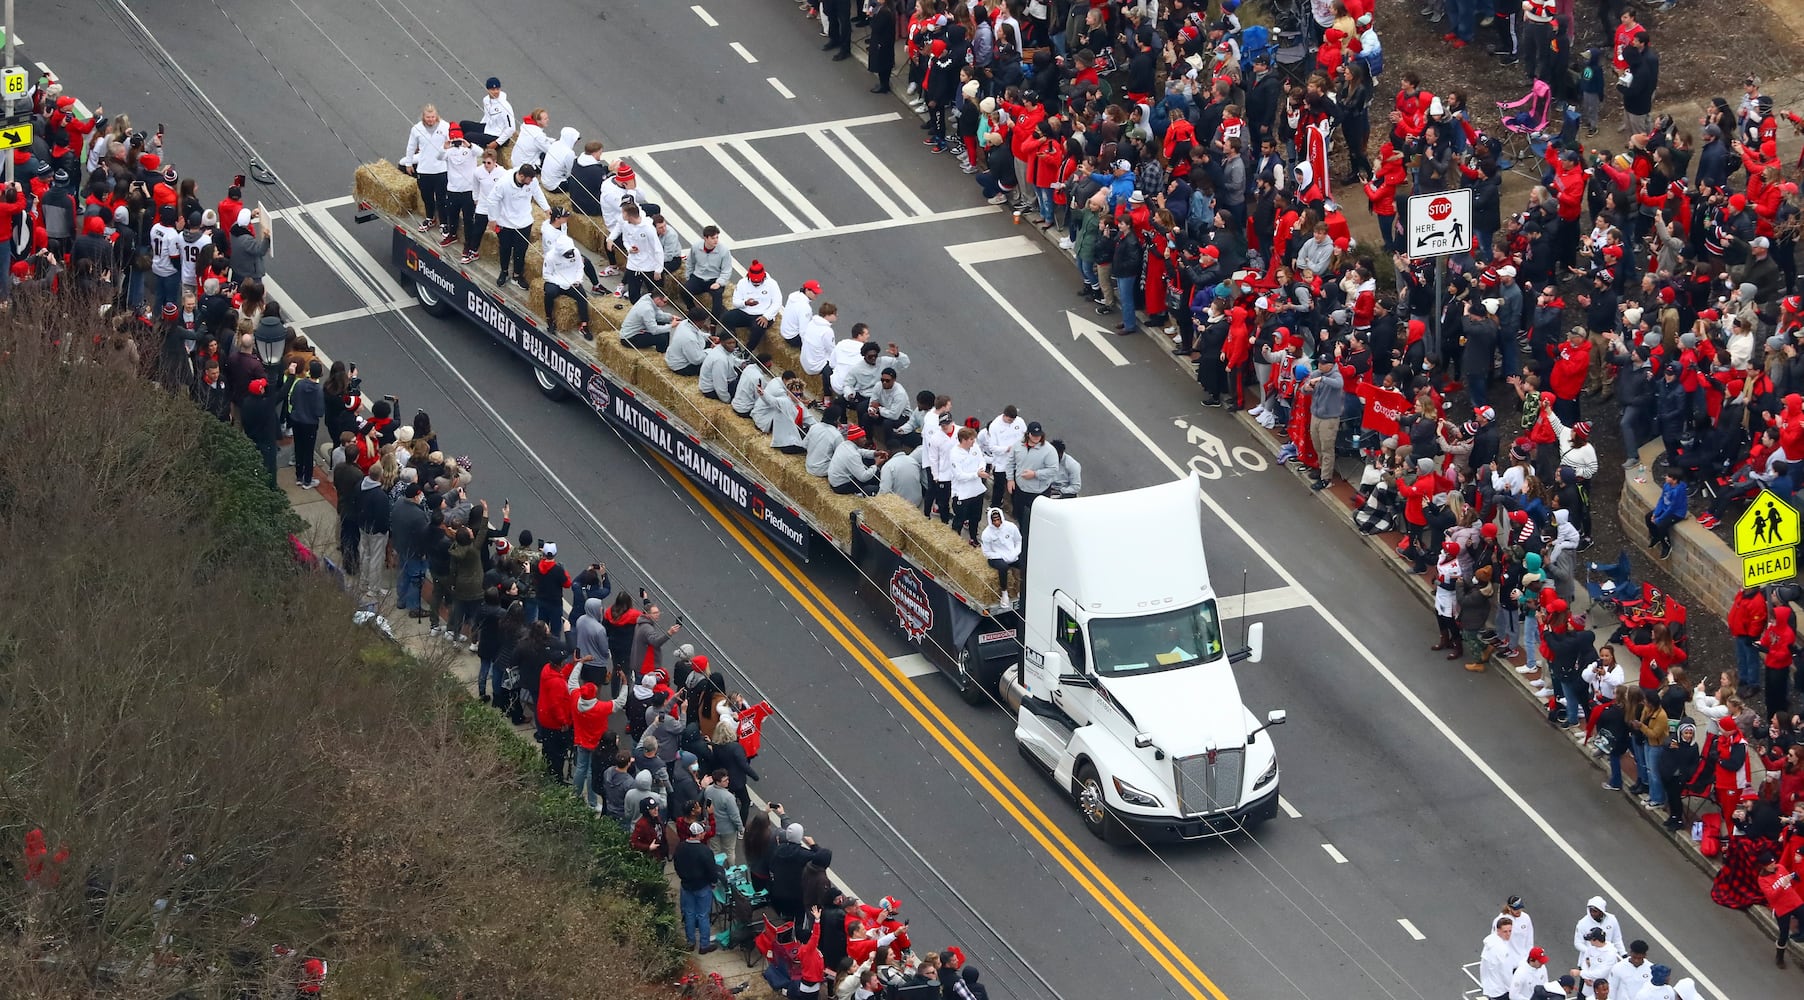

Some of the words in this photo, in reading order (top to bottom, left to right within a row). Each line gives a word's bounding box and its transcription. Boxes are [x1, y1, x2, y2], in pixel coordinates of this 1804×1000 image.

[9, 77, 23, 92] 6B
[1429, 203, 1451, 216] STOP
[1415, 223, 1436, 234] HERE
[184, 245, 200, 263] 19
[1432, 238, 1448, 248] FOR
[418, 259, 456, 296] Piedmont
[467, 290, 518, 343] GEORGIA
[522, 329, 582, 389] BULLDOGS
[615, 396, 673, 454] NATIONAL
[676, 440, 748, 508] CHAMPIONS
[764, 507, 804, 546] Piedmont
[1748, 556, 1791, 579] AHEAD
[892, 583, 930, 625] CHAMPIONS
